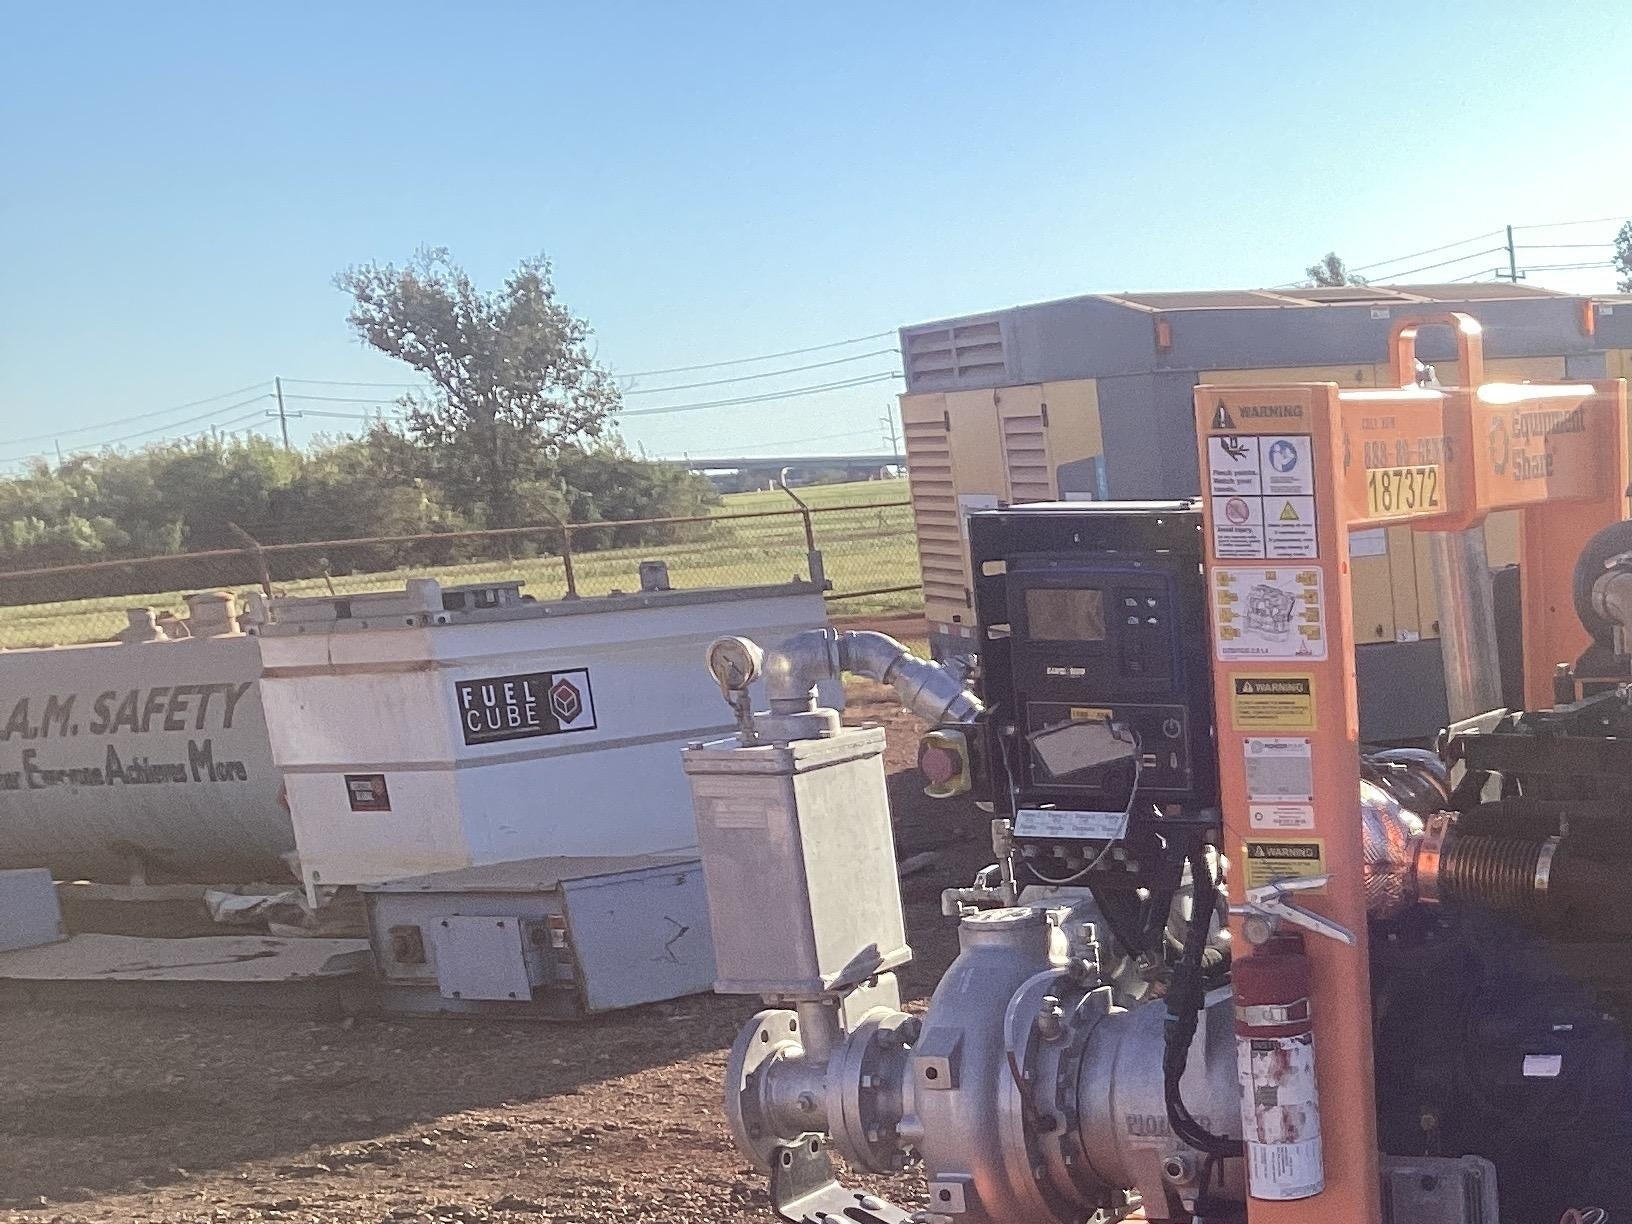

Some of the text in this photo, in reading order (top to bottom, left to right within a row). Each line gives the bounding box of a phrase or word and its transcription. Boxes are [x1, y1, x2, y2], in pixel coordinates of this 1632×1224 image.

[1240, 404, 1303, 418] WARNING
[1511, 407, 1586, 444] Equipment
[1511, 450, 1553, 482] Share
[1369, 471, 1439, 513] 187372
[461, 681, 536, 709] FUEL
[1255, 682, 1304, 692] WARNING
[90, 682, 252, 736] SAFETY
[466, 703, 540, 732] CUBE
[1266, 847, 1313, 857] WARNING
